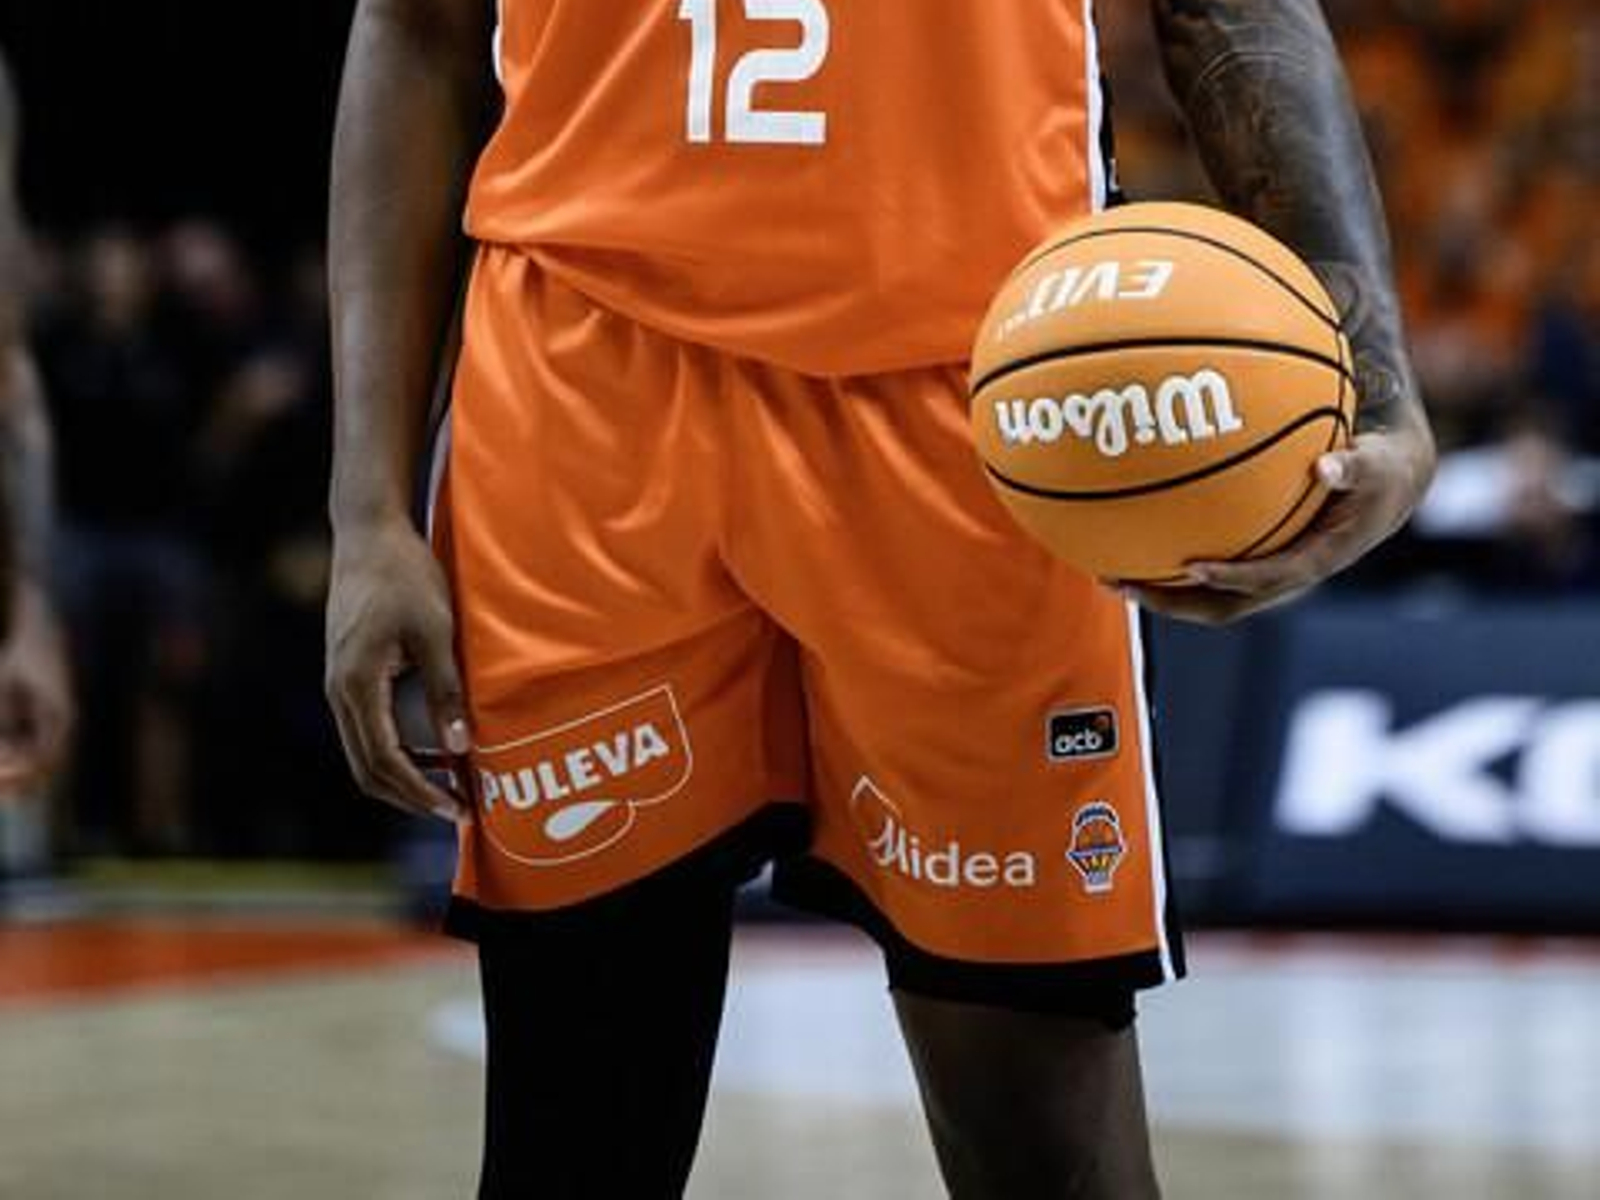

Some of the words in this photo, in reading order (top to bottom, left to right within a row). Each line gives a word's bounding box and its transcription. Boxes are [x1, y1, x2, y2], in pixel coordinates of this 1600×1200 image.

[994, 369, 1243, 457] Wilson
[480, 723, 670, 813] PULEVA
[1055, 729, 1104, 754] acb
